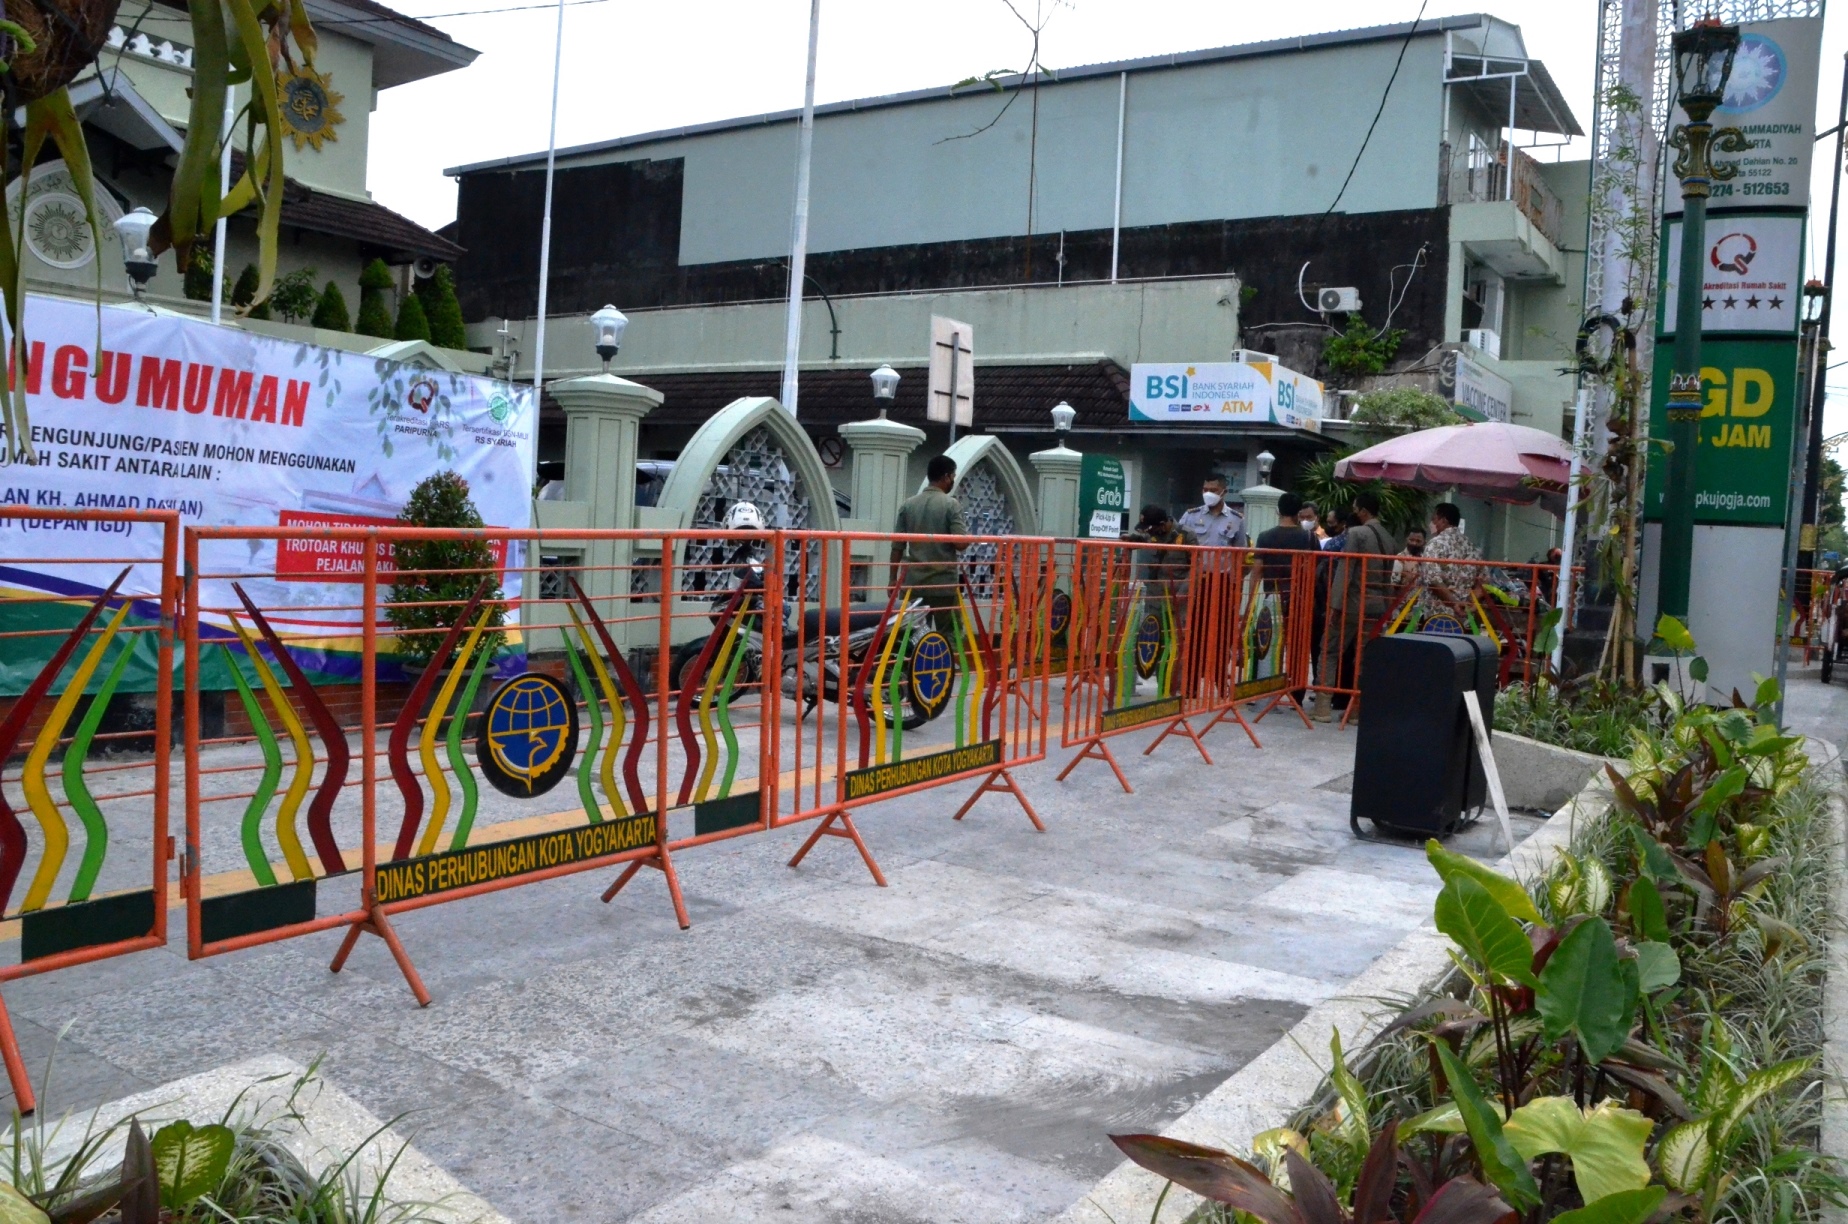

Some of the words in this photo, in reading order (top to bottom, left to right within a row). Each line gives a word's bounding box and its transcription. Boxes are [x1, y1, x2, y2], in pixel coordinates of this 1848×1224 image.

[1738, 124, 1802, 136] AMMADIYAH
[1743, 158, 1772, 166] Dahlan
[1748, 169, 1772, 177] 55122
[1709, 183, 1733, 197] 274
[1743, 182, 1790, 195] 512653
[1703, 282, 1739, 291] Akreditasi
[1741, 281, 1766, 290] Rumah
[1768, 281, 1787, 290] Sakit
[1146, 374, 1188, 399] BSI
[1192, 383, 1216, 391] BANK
[1217, 382, 1254, 391] SYARIAH
[1700, 366, 1775, 418] GD
[1192, 391, 1240, 399] INDONESIA
[1278, 379, 1295, 410] BSI
[1221, 401, 1253, 413] ATM
[386, 413, 428, 427] Terakreditasi
[394, 424, 438, 438] PARIPURNA
[462, 423, 500, 437] Tersertifikasi
[1712, 424, 1771, 448] JAM
[475, 435, 485, 445] RS
[486, 436, 517, 448] SYARIAH
[30, 425, 200, 458] ENGUNJUNG/PASIEN
[203, 443, 255, 463] MOHON
[258, 449, 356, 474] MENGGUNAKAN
[57, 451, 111, 471] SAKIT
[0, 488, 30, 504] AN
[37, 489, 67, 506] KH.
[74, 492, 140, 509] AHMAD
[1097, 486, 1122, 506] Grab
[284, 538, 337, 553] TROTOAR
[341, 541, 386, 556] KHUS
[316, 557, 365, 572] PEJALAN
[375, 560, 393, 572] AKI
[850, 773, 875, 797] DINAS
[876, 758, 932, 791] PERHUBUNGAN
[933, 754, 951, 775] KOTA
[953, 744, 994, 770] YOGYAKARTA
[377, 865, 425, 901] DINAS
[428, 844, 537, 891] PERHUBUNGAN
[539, 834, 574, 865] KOTA
[575, 816, 657, 854] YOGYAKARTA
